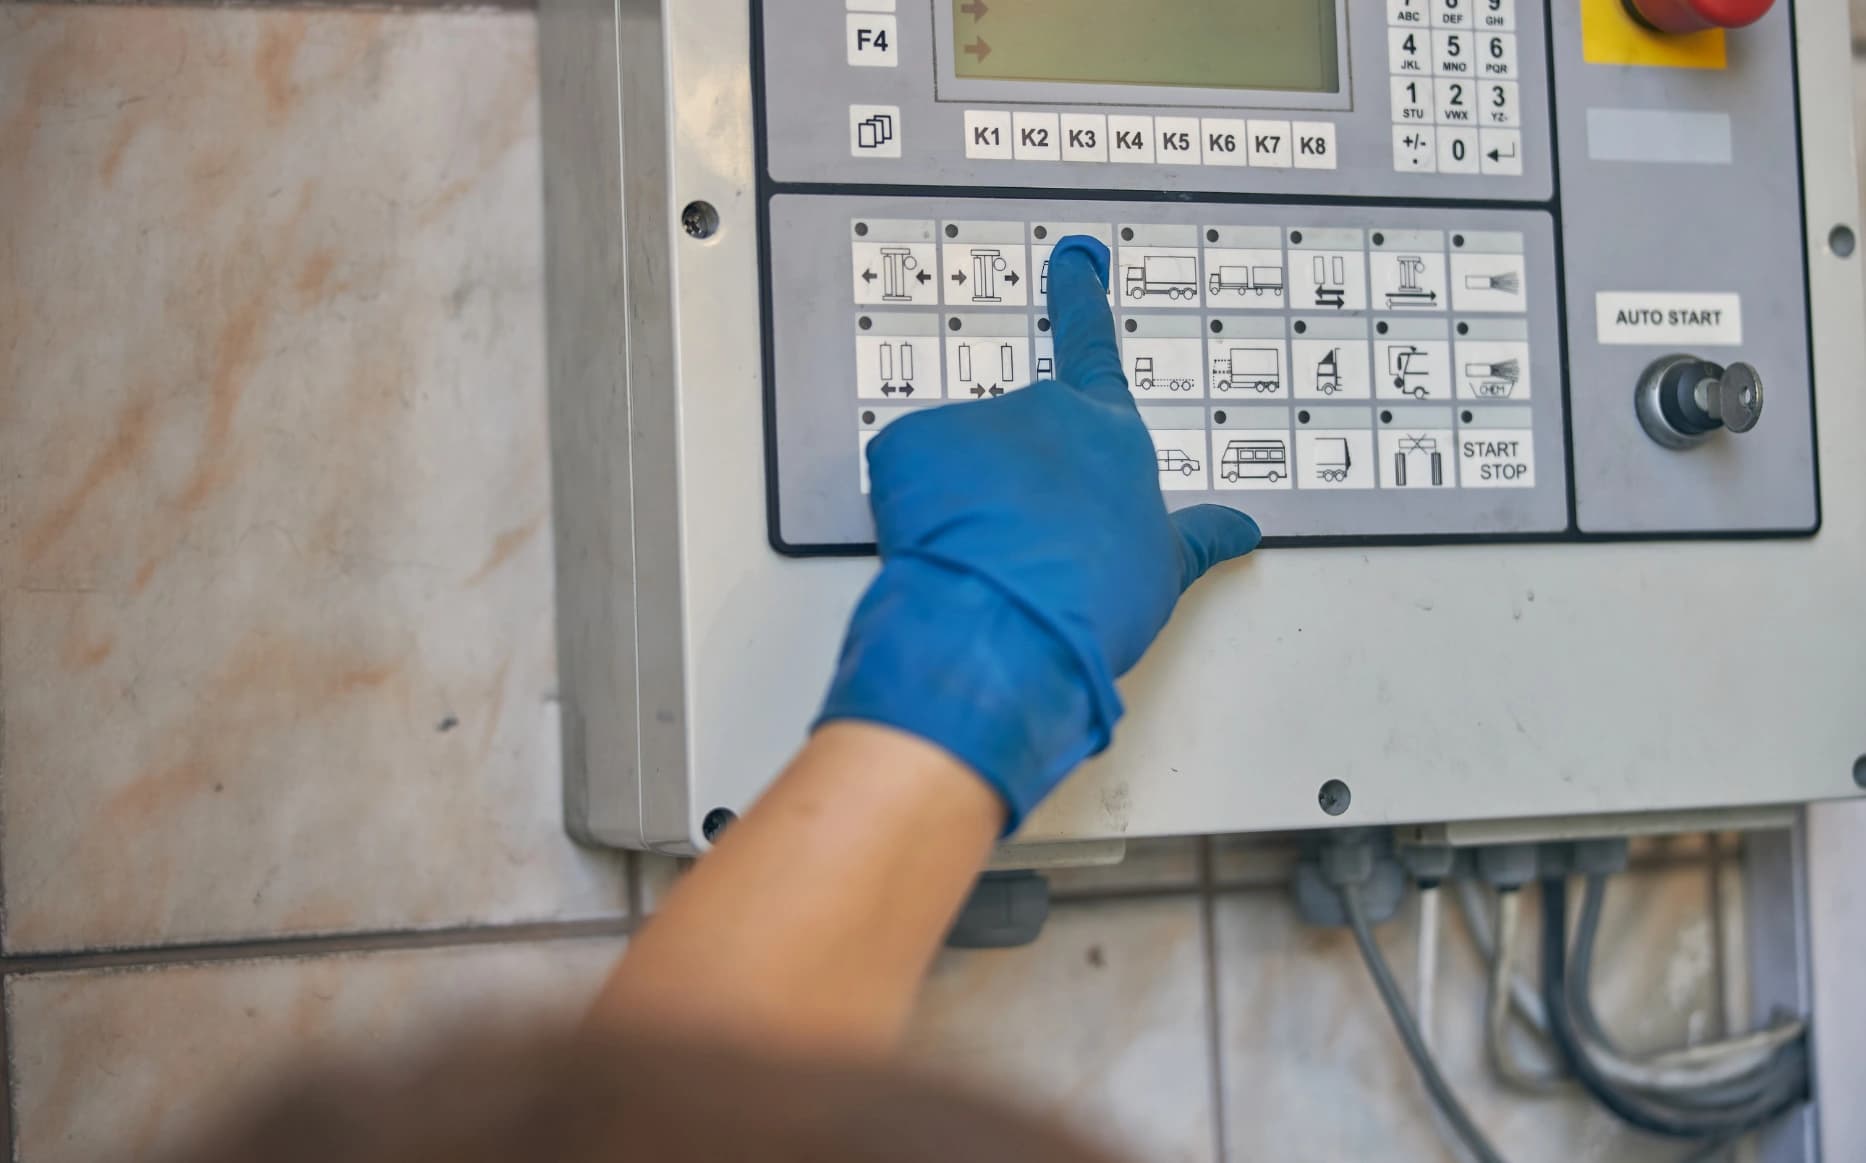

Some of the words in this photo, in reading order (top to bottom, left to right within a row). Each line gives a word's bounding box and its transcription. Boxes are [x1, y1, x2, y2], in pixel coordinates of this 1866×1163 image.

[1398, 12, 1419, 21] ABC
[1443, 14, 1463, 24] DEF
[1486, 16, 1503, 25] GHI
[858, 29, 888, 51] F4
[1403, 34, 1416, 54] 4
[1448, 36, 1460, 56] 5
[1490, 37, 1503, 58] 6
[1401, 60, 1420, 70] JKL
[1443, 62, 1466, 72] MNO
[1486, 64, 1507, 73] PQR
[1407, 82, 1416, 103] 1
[1450, 84, 1462, 105] 2
[1493, 86, 1505, 107] 3
[1403, 109, 1423, 119] STU
[1445, 111, 1467, 120] VWX
[975, 127, 999, 145] K1
[1022, 128, 1048, 146] K2
[1069, 130, 1096, 148] K3
[1116, 131, 1143, 149] K4
[1163, 133, 1189, 150] K5
[1210, 134, 1235, 152] K6
[1256, 136, 1280, 153] K7
[1301, 137, 1325, 155] K8
[1453, 140, 1464, 160] 0
[1616, 310, 1663, 325] AUTO
[1668, 310, 1722, 325] START
[1463, 442, 1519, 457] START
[1481, 464, 1527, 480] STOP
